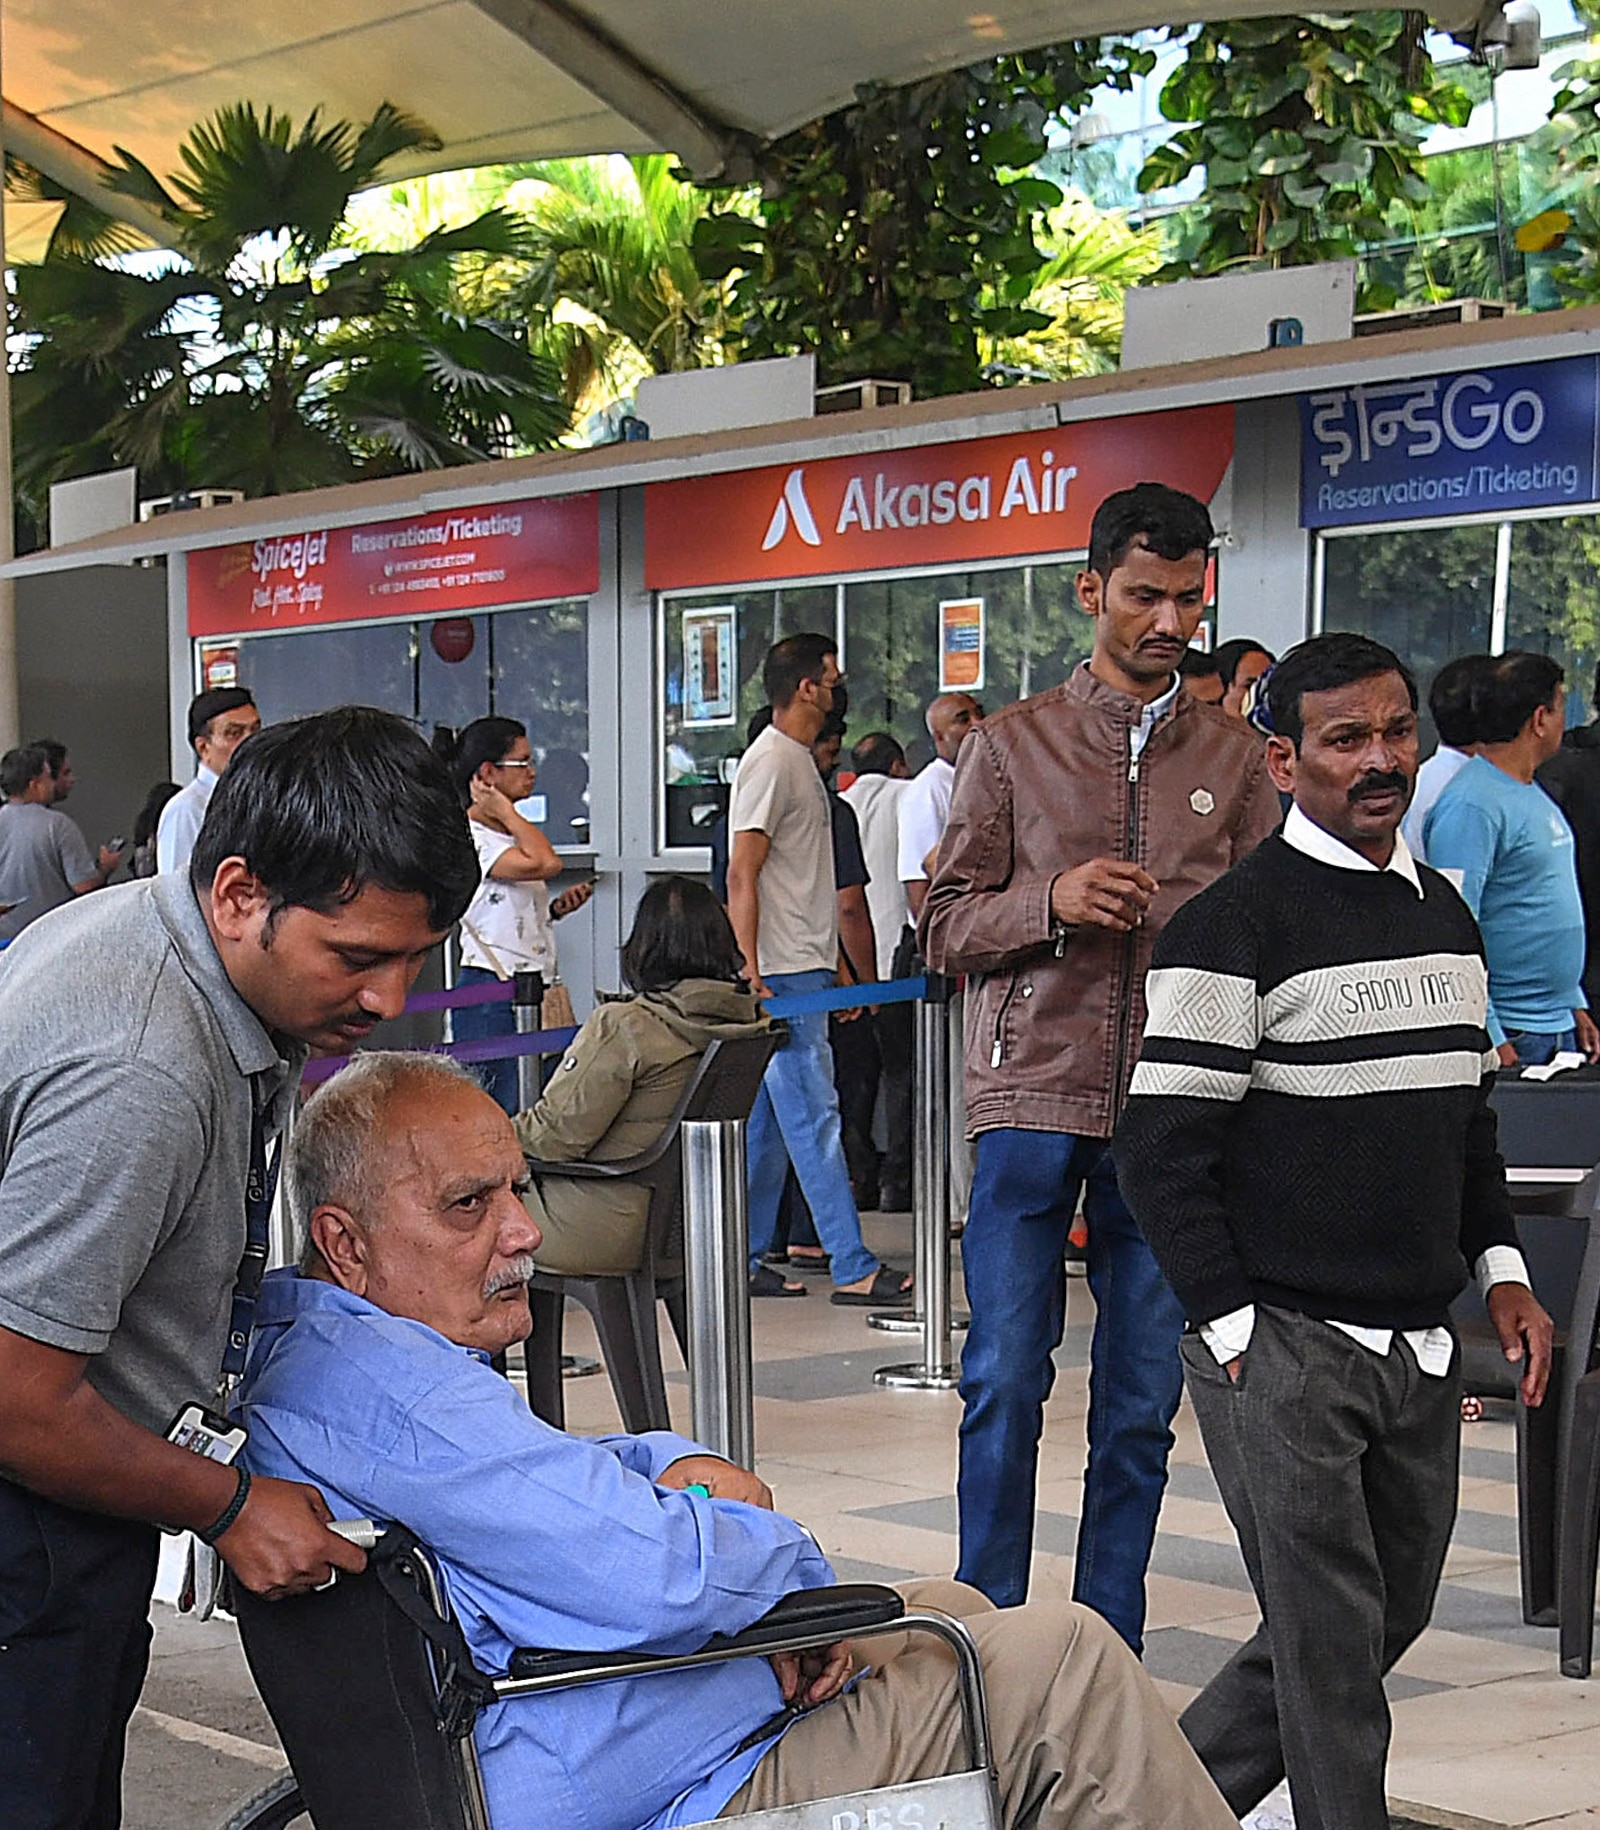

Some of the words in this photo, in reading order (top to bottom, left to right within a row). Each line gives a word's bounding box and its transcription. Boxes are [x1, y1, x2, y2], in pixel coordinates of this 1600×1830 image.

[835, 472, 991, 535] Akasa
[999, 449, 1078, 518] Air
[1317, 461, 1579, 513] Reservations/Ticketing
[251, 531, 329, 583] SpiceJet
[351, 514, 522, 553] Reservations/Ticketing
